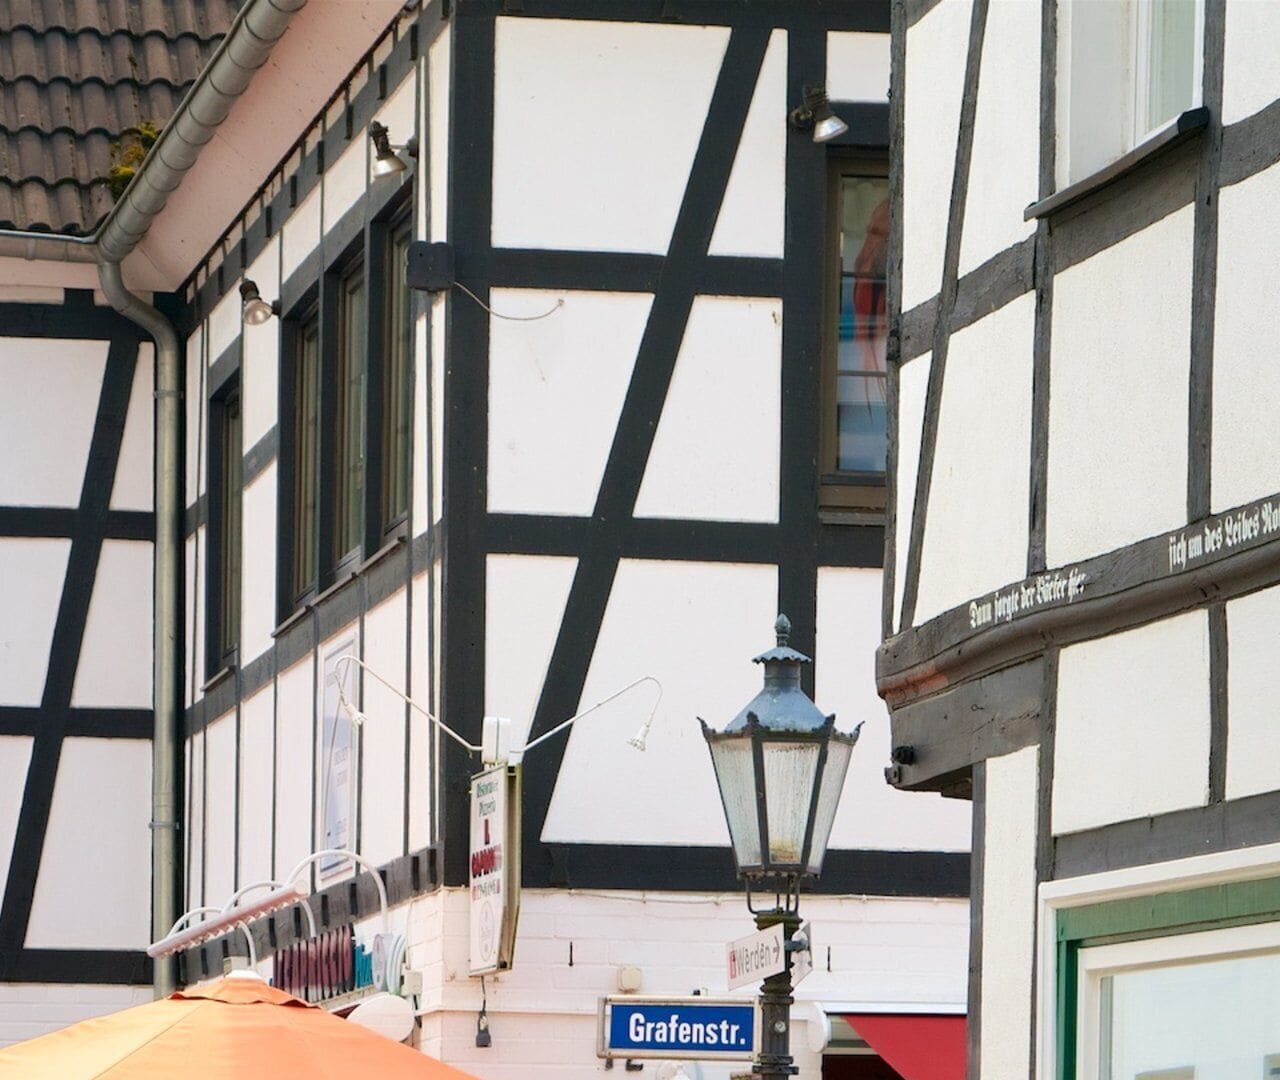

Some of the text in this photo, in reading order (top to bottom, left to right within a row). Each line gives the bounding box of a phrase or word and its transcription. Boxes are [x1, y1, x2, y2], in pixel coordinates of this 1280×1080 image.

[1205, 519, 1223, 553] des
[1225, 506, 1260, 547] Leibes
[736, 941, 772, 977] Werden
[628, 1012, 746, 1046] Grafenstr.
